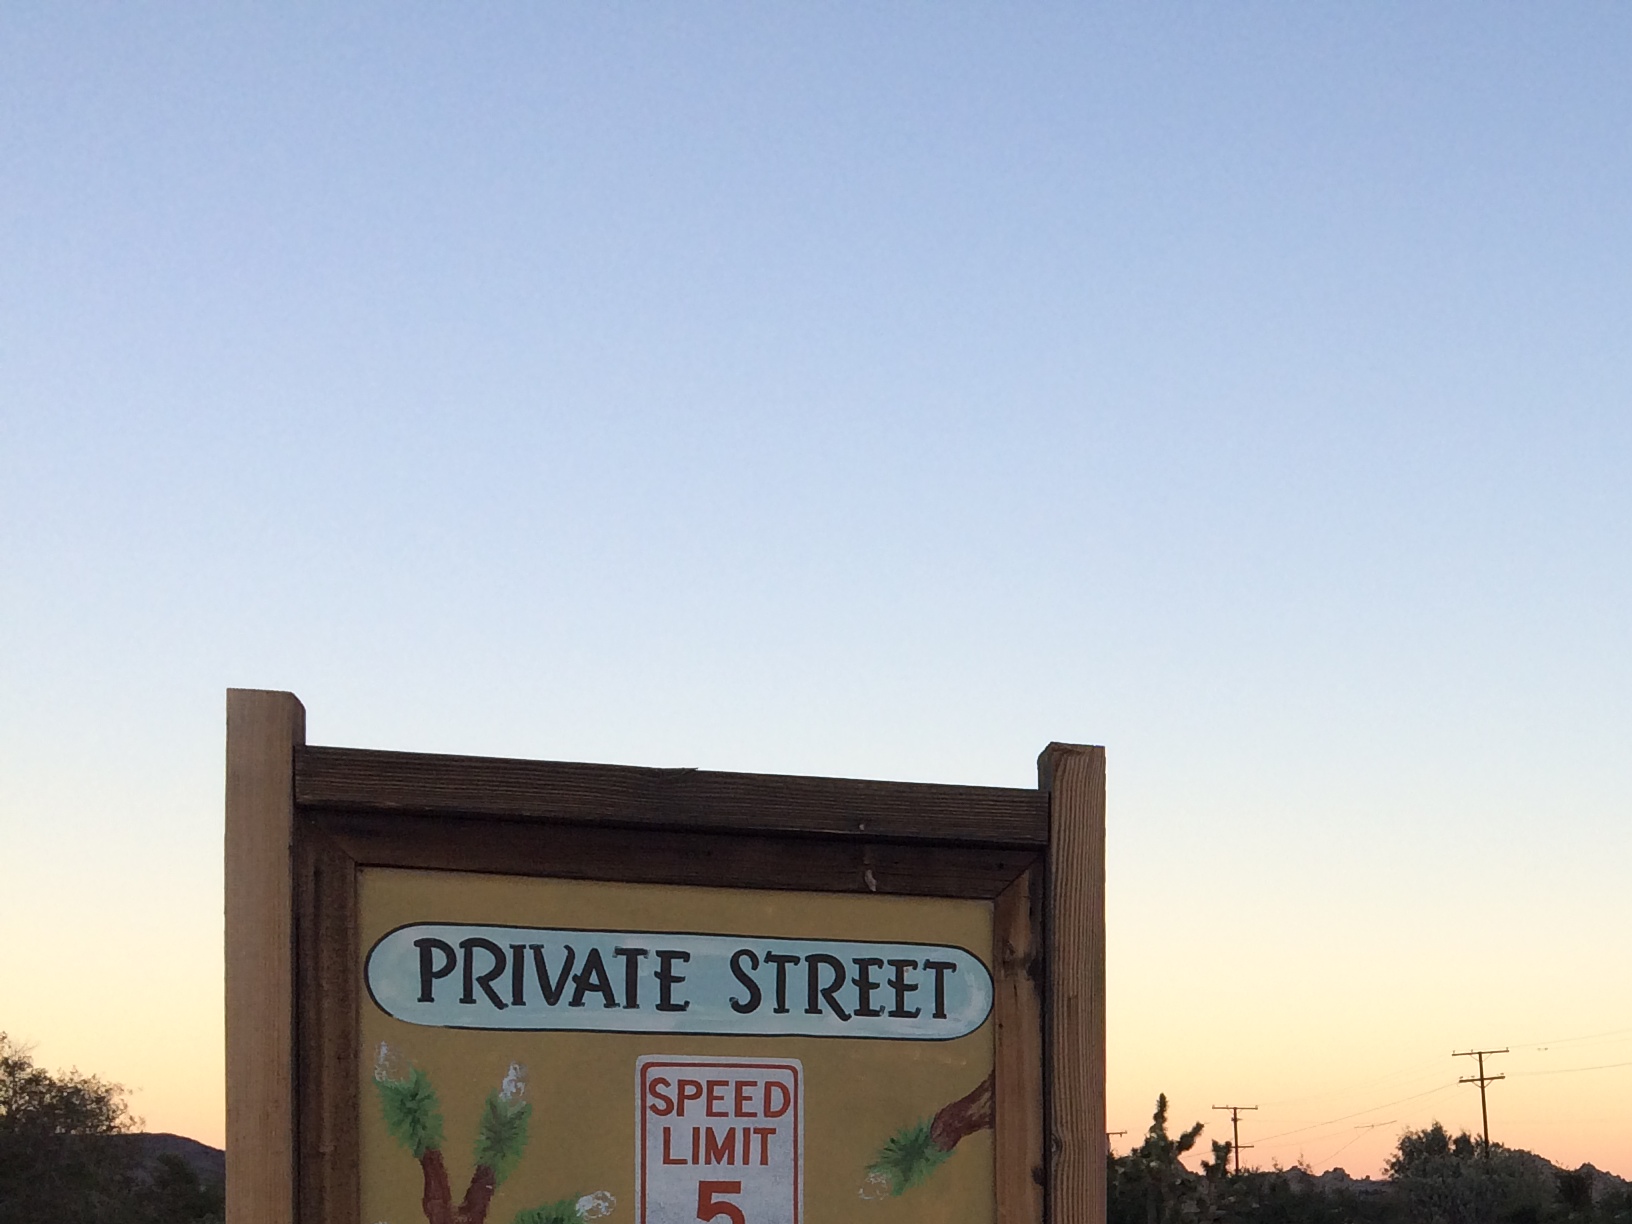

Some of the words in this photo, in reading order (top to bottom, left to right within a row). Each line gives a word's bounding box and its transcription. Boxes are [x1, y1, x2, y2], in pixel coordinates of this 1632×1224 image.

[414, 937, 690, 1011] PRIVATE
[729, 948, 957, 1022] STREET
[648, 1077, 792, 1118] SPEED
[663, 1127, 777, 1166] LIMIT
